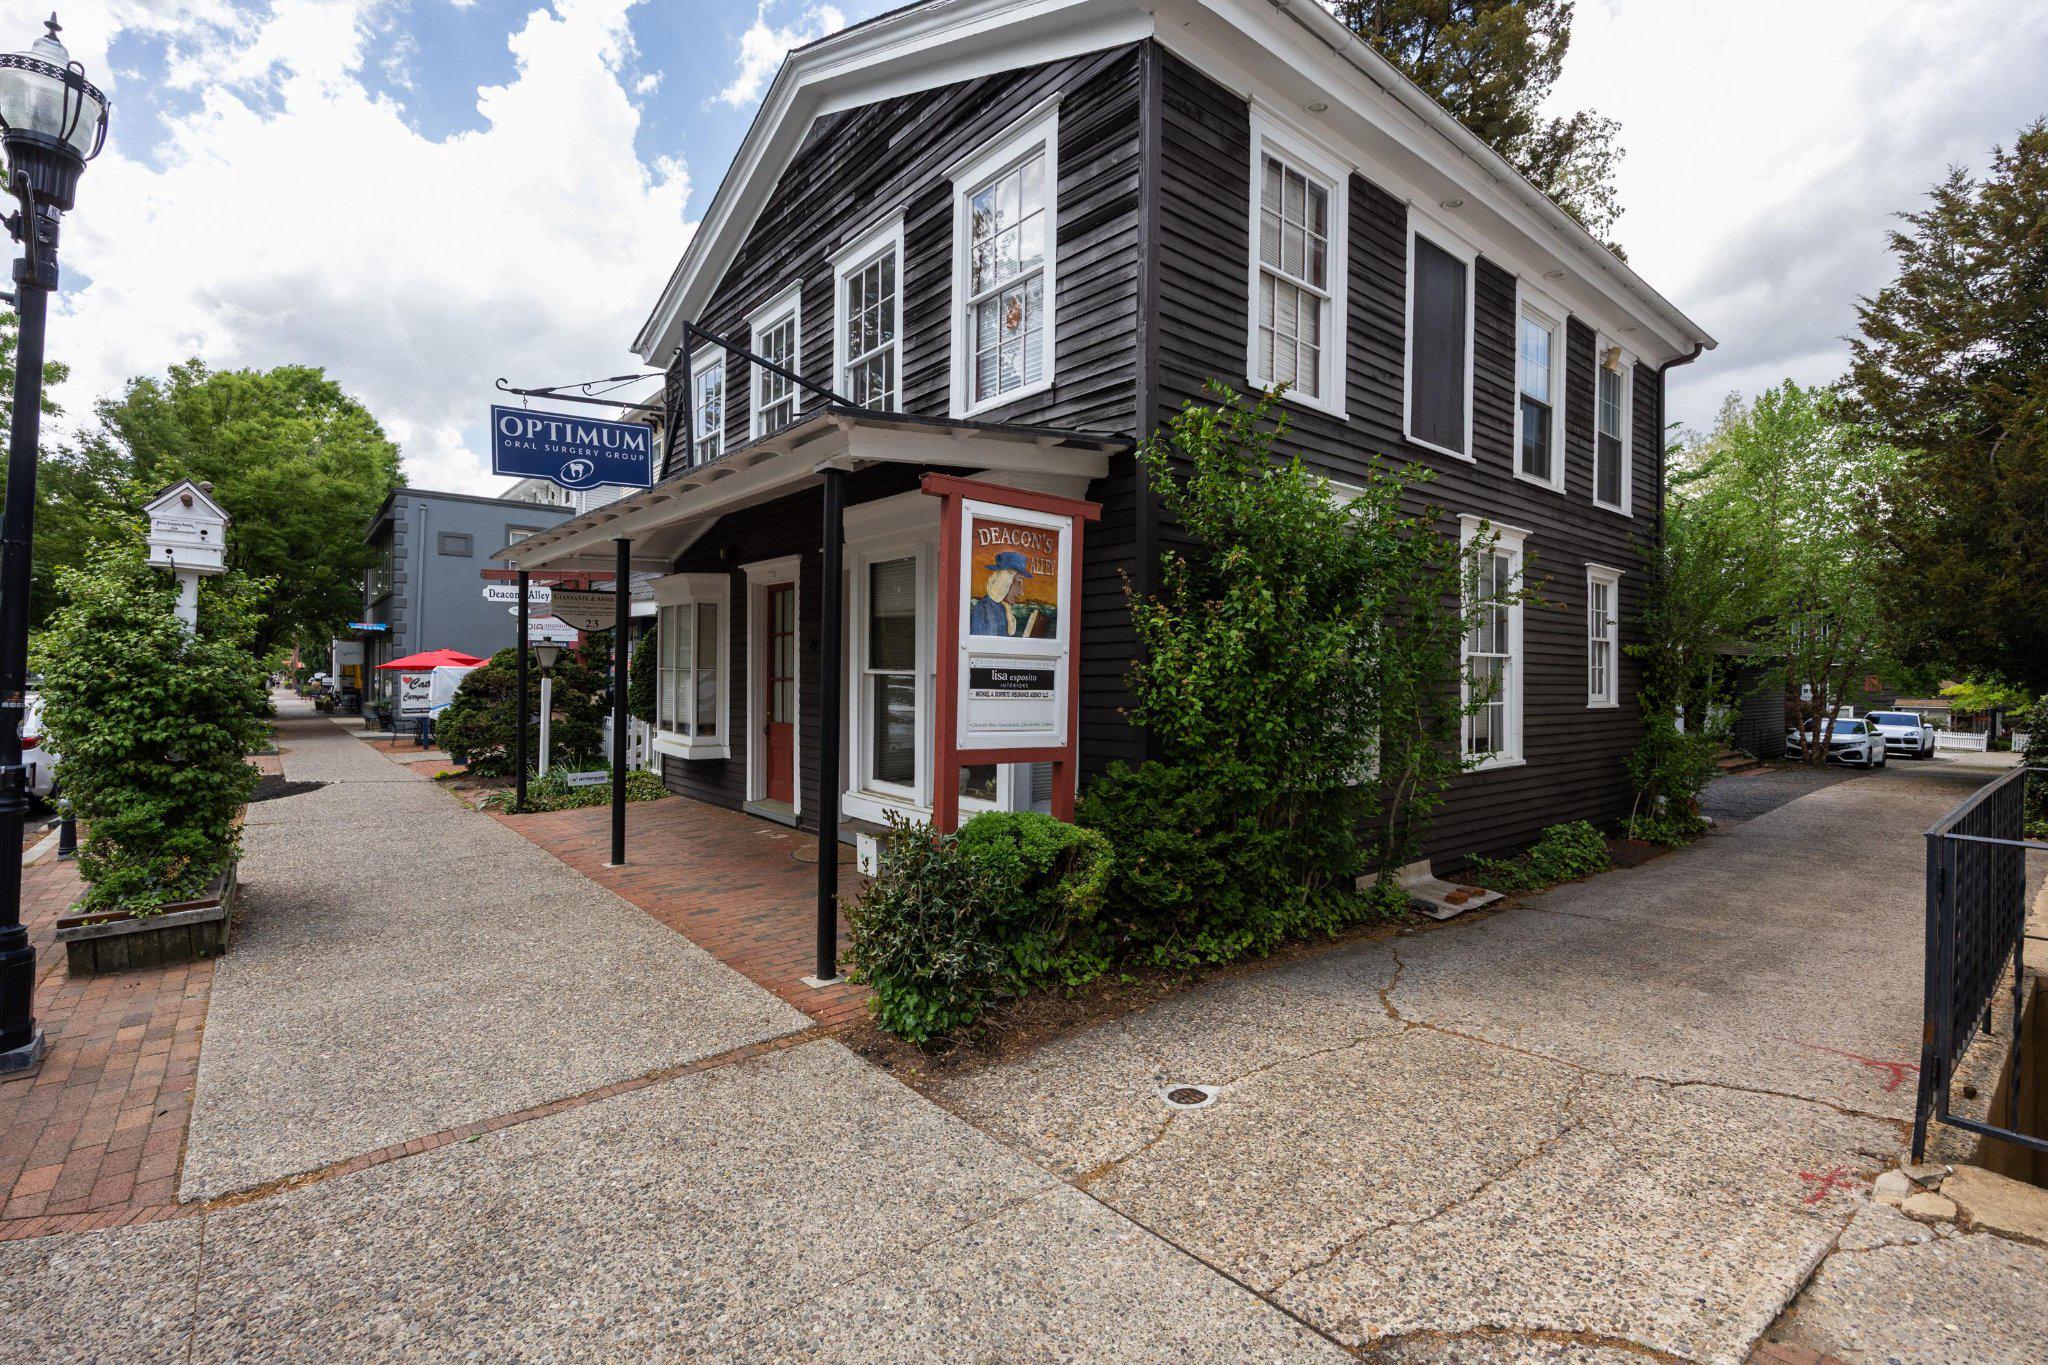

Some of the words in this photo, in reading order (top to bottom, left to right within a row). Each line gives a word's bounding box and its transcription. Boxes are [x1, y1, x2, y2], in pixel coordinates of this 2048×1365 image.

[500, 416, 646, 451] OPTIMUM
[504, 439, 538, 450] ORAL
[545, 444, 599, 457] SURGERY
[606, 451, 645, 461] GROUP
[978, 527, 1053, 554] DEACON'S
[528, 590, 550, 602] Alley
[585, 619, 599, 628] 23
[991, 669, 1008, 681] lisa
